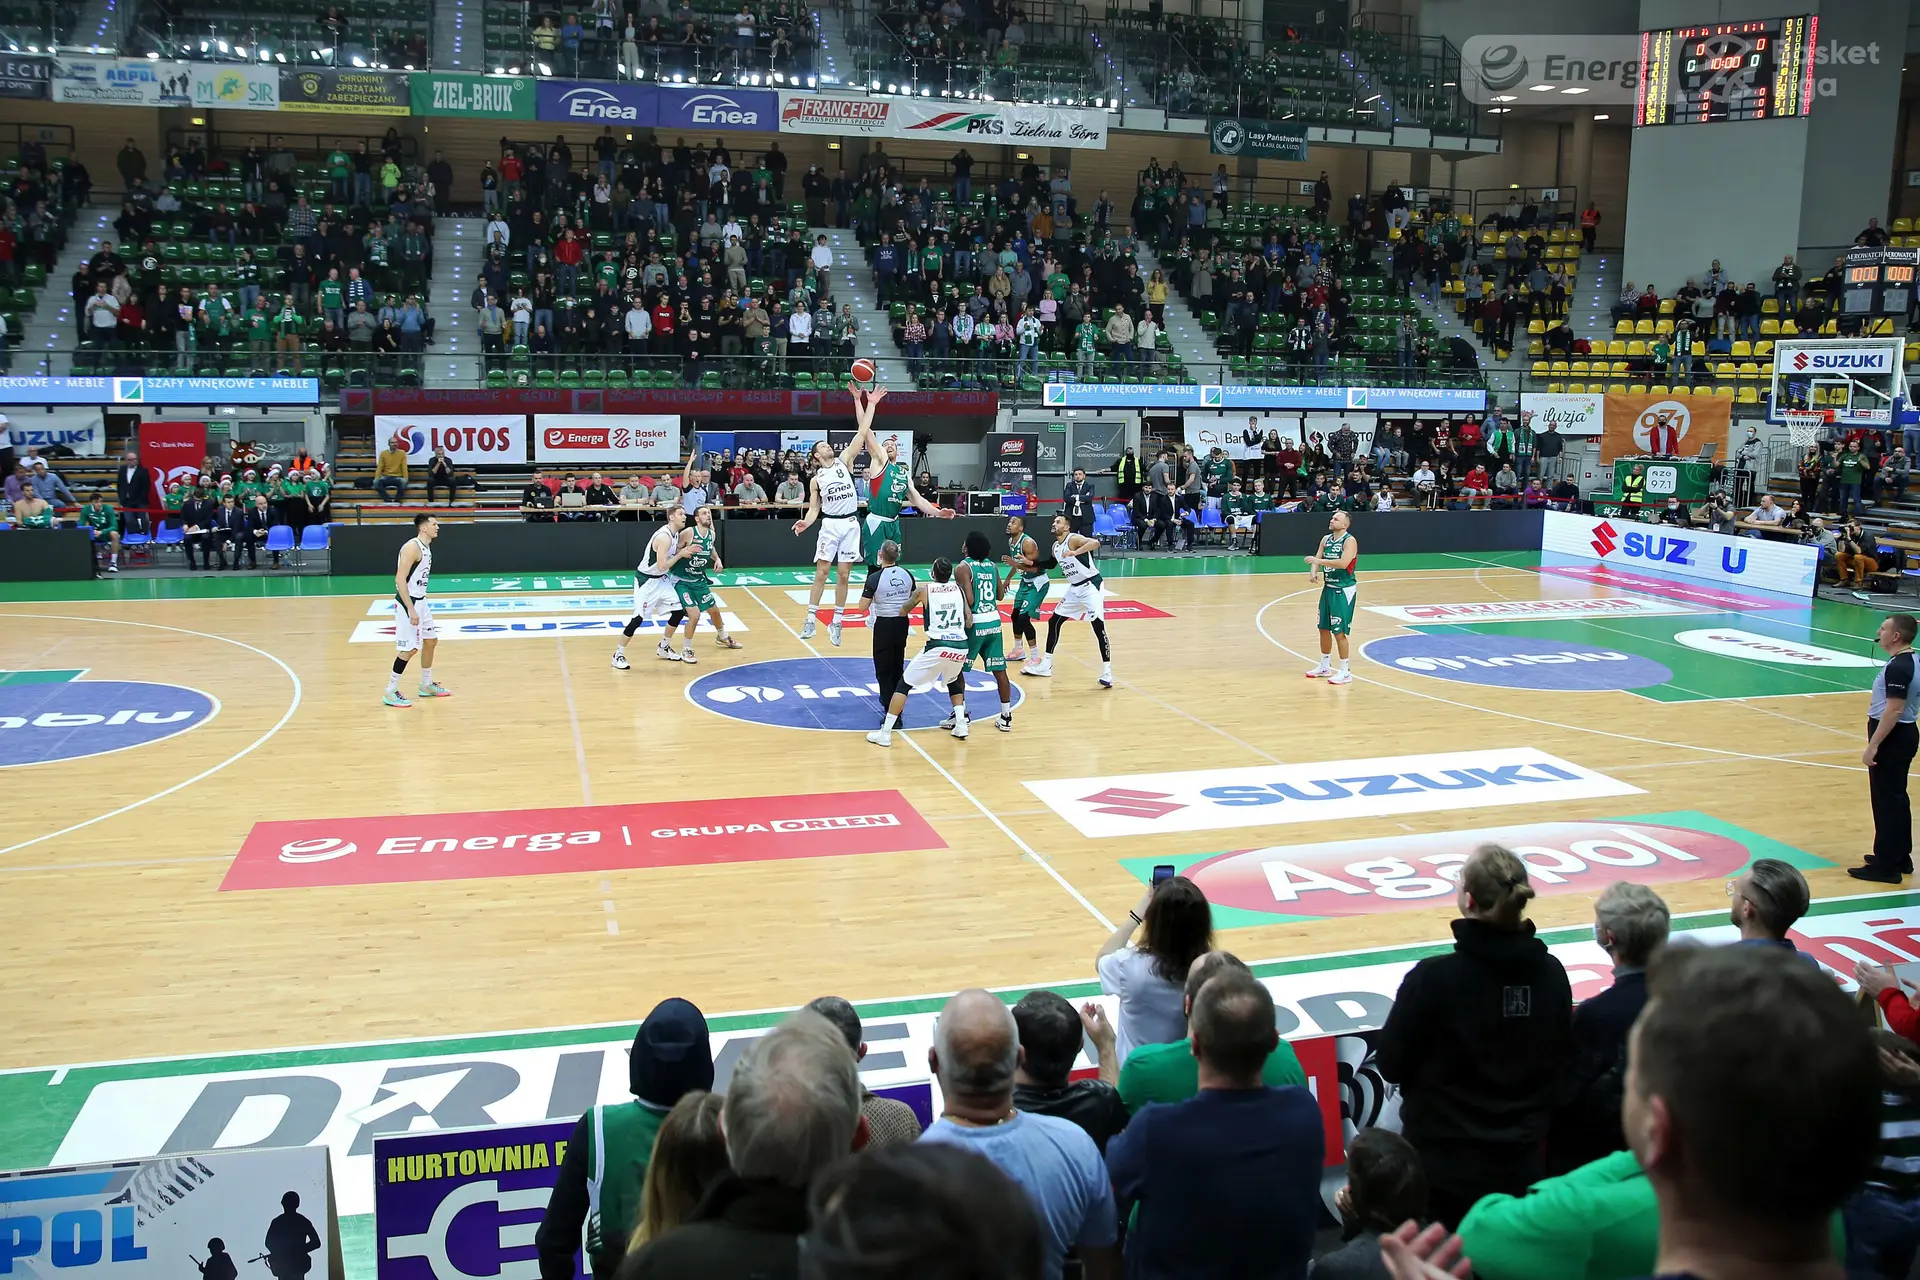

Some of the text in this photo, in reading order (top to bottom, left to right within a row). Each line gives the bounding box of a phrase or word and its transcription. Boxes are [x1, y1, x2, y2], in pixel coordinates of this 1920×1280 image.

[1696, 44, 1705, 56] 0
[1756, 38, 1766, 51] 0
[1711, 56, 1741, 70] 10:00
[1750, 54, 1760, 67] 0
[338, 75, 384, 84] CHRONIMY
[336, 84, 387, 94] SPRZĄTAMY
[433, 81, 512, 111] ZIEL-BRUK
[327, 93, 397, 104] ZABEZPIECZAMY
[569, 98, 637, 120] Enea
[692, 105, 758, 125] Enea
[803, 100, 890, 118] FRANCEPOL
[801, 117, 841, 125] TRANSPORT
[849, 118, 885, 126] SPEDYCJA
[967, 118, 1100, 141] PKS Zielona Góra
[1248, 131, 1304, 144] Lasy Państwowe
[1846, 251, 1884, 260] AEROWATCH
[1885, 250, 1917, 259] AEROWATCH
[1812, 354, 1884, 368] SUZUKI
[67, 378, 105, 388] MEBLE
[147, 379, 310, 390] SZAFY WNĘKOWE MEBLE
[1070, 383, 1195, 396] SZAFY WNĘKOWE MEBLE
[1225, 386, 1342, 397] SZAFY WNĘKOWE MEBLE
[1370, 388, 1480, 399] SZAFY WNĘKOWE MEBLE
[1542, 406, 1588, 429] iluzja
[431, 427, 510, 452] LOTOS
[567, 429, 667, 445] Energa Basket
[635, 439, 655, 449] Liga
[836, 468, 845, 478] 8
[827, 483, 851, 495] Enea
[1650, 479, 1671, 489] 97.1
[1623, 531, 1748, 574] SUZ U
[977, 580, 994, 601] 18
[1448, 598, 1636, 615] FRANCEPOL
[935, 610, 962, 630] 34
[1462, 650, 1629, 669] inblu
[1738, 641, 1831, 663] LOTOS
[1199, 763, 1583, 807] SUZUKI
[376, 816, 891, 855] Energa GRUPA ORLEN
[387, 1143, 550, 1183] HURTOWNIA
